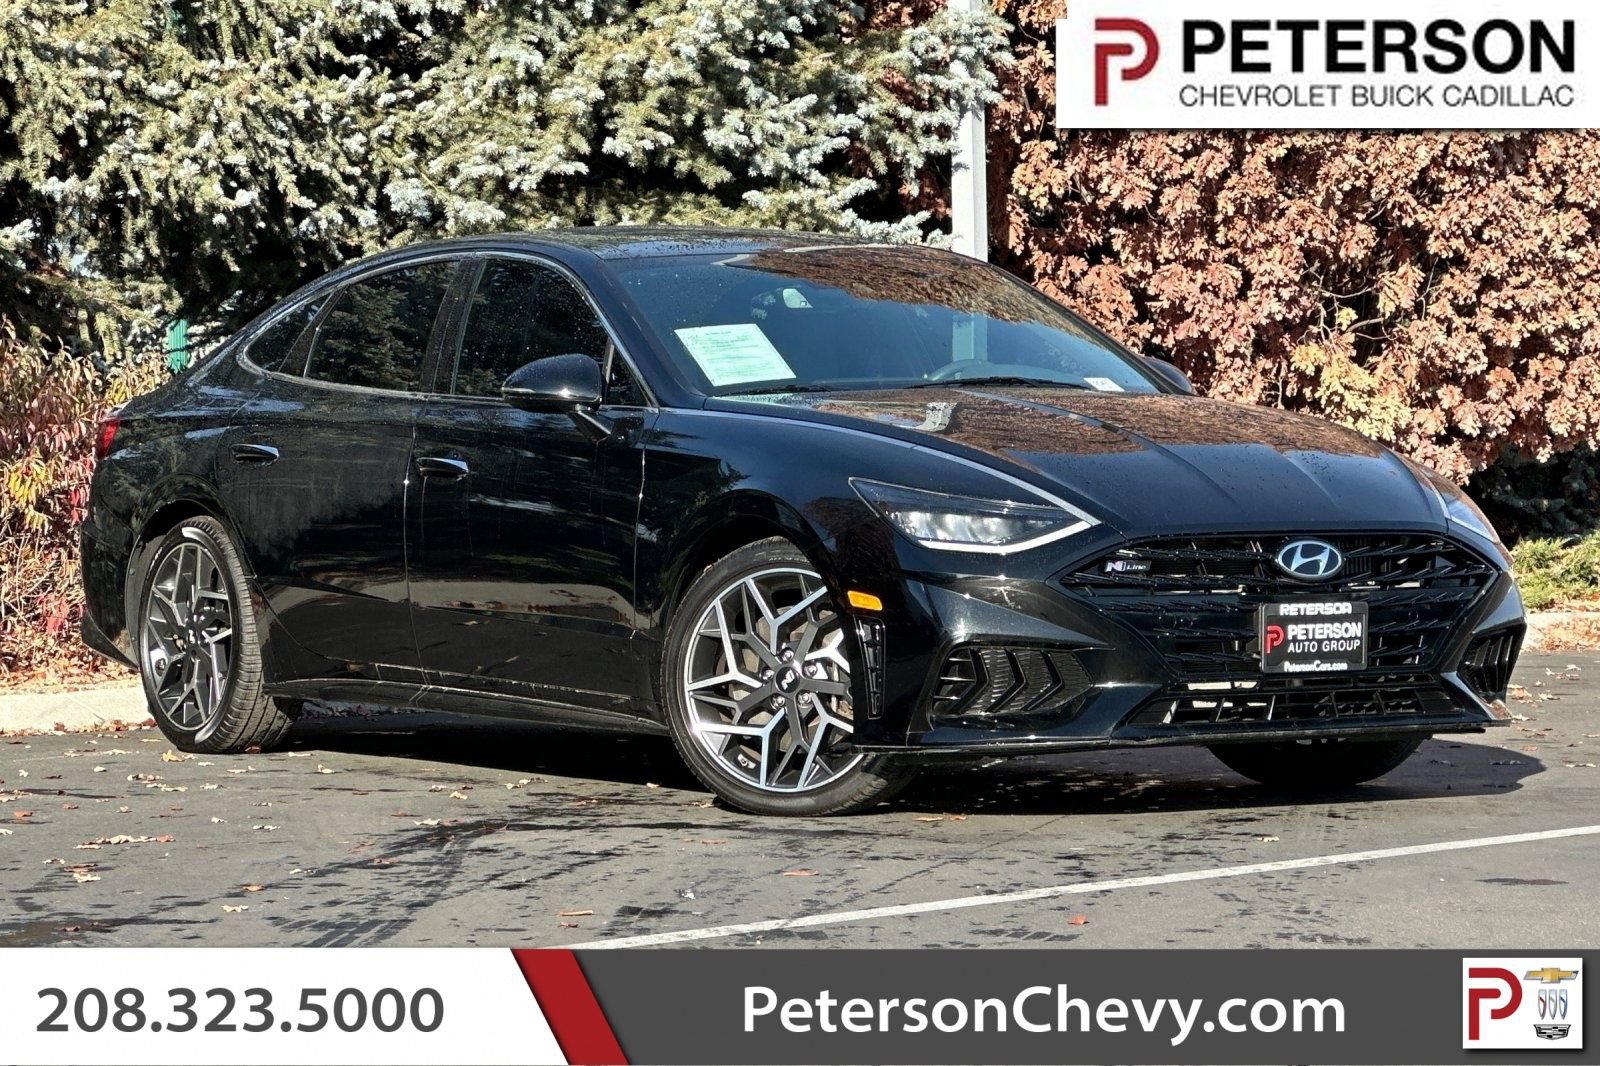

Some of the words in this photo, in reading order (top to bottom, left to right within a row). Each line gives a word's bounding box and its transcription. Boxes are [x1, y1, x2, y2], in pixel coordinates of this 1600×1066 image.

[1287, 622, 1362, 640] PETERSON
[1287, 641, 1318, 653] AUTO
[1322, 639, 1361, 652] GROUP
